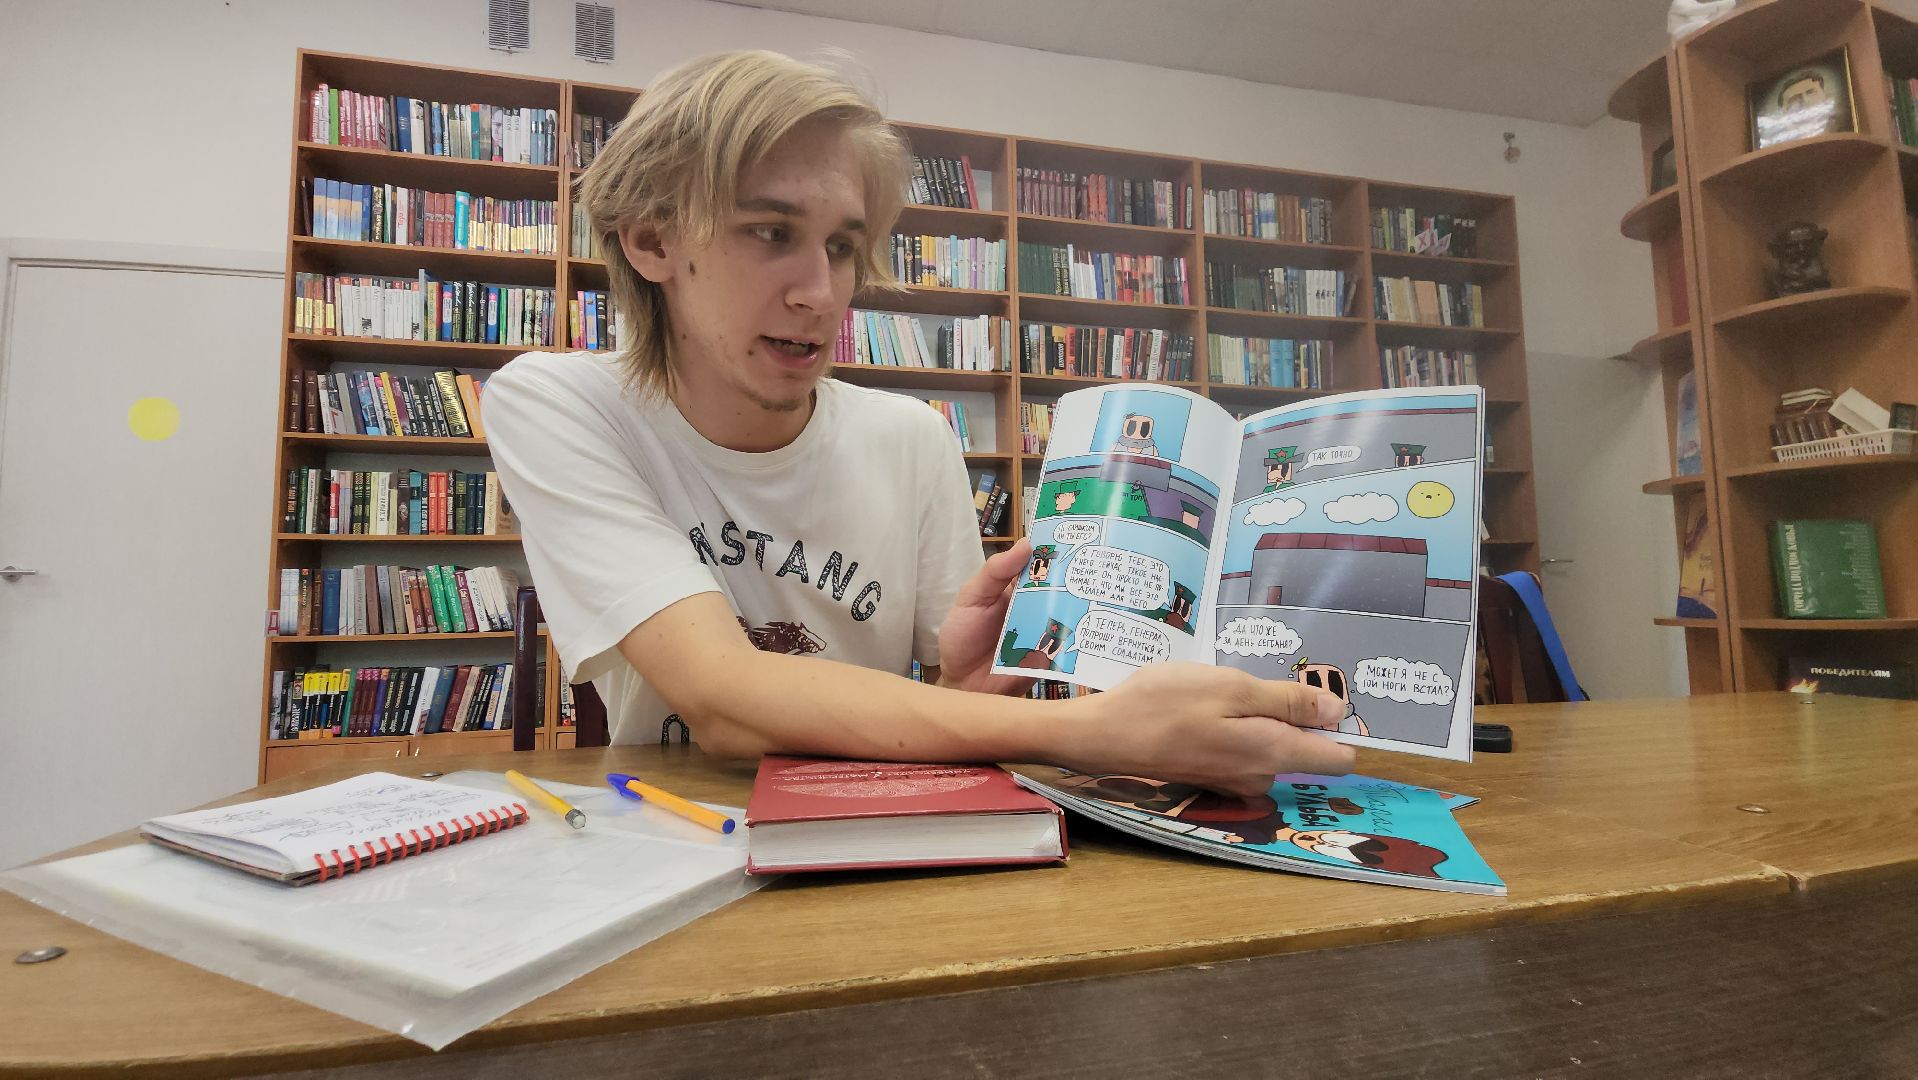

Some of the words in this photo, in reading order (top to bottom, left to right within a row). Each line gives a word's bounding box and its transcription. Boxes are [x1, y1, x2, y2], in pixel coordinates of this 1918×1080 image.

[1312, 451, 1328, 461] ТАК
[1331, 449, 1353, 460] ТОЧНО
[1078, 558, 1094, 567] НЕГО
[1098, 561, 1123, 572] СЕЙЧАС
[1127, 566, 1147, 578] ТАКОЕ
[1080, 548, 1087, 556] Я
[1090, 549, 1123, 561] ГОВОРЮ
[1150, 561, 1164, 573] ЭТО
[1102, 570, 1112, 580] ОН
[1116, 574, 1140, 586] ПРОСТО
[1144, 581, 1153, 589] НЕ
[1078, 585, 1106, 598] ДЕЛАЕМ
[1110, 593, 1125, 603] ДЛЯ
[1100, 580, 1113, 591] ЧТО
[1146, 592, 1159, 601] ЭТО
[1082, 614, 1091, 628] А
[1233, 623, 1246, 635] ДА
[1250, 624, 1264, 636] ЧТО
[1265, 625, 1277, 637] ЖЕ
[1079, 627, 1115, 643] ПОПРОШУ
[1222, 636, 1231, 646] ЗА
[1234, 637, 1254, 648] ДЕНЬ
[1079, 638, 1106, 652] СВОИМ
[1112, 646, 1154, 664] СОЛДАТАМ
[1366, 664, 1398, 679] МОЖЕТ
[1400, 668, 1407, 680] Я
[1432, 673, 1438, 683] С
[1810, 667, 1891, 678] ПОБЕДИТЕЛЯМ
[1382, 681, 1407, 692] НОГИ
[1413, 683, 1450, 697] ВСТАЛ?
[1290, 782, 1341, 828] БУЛЬБА
